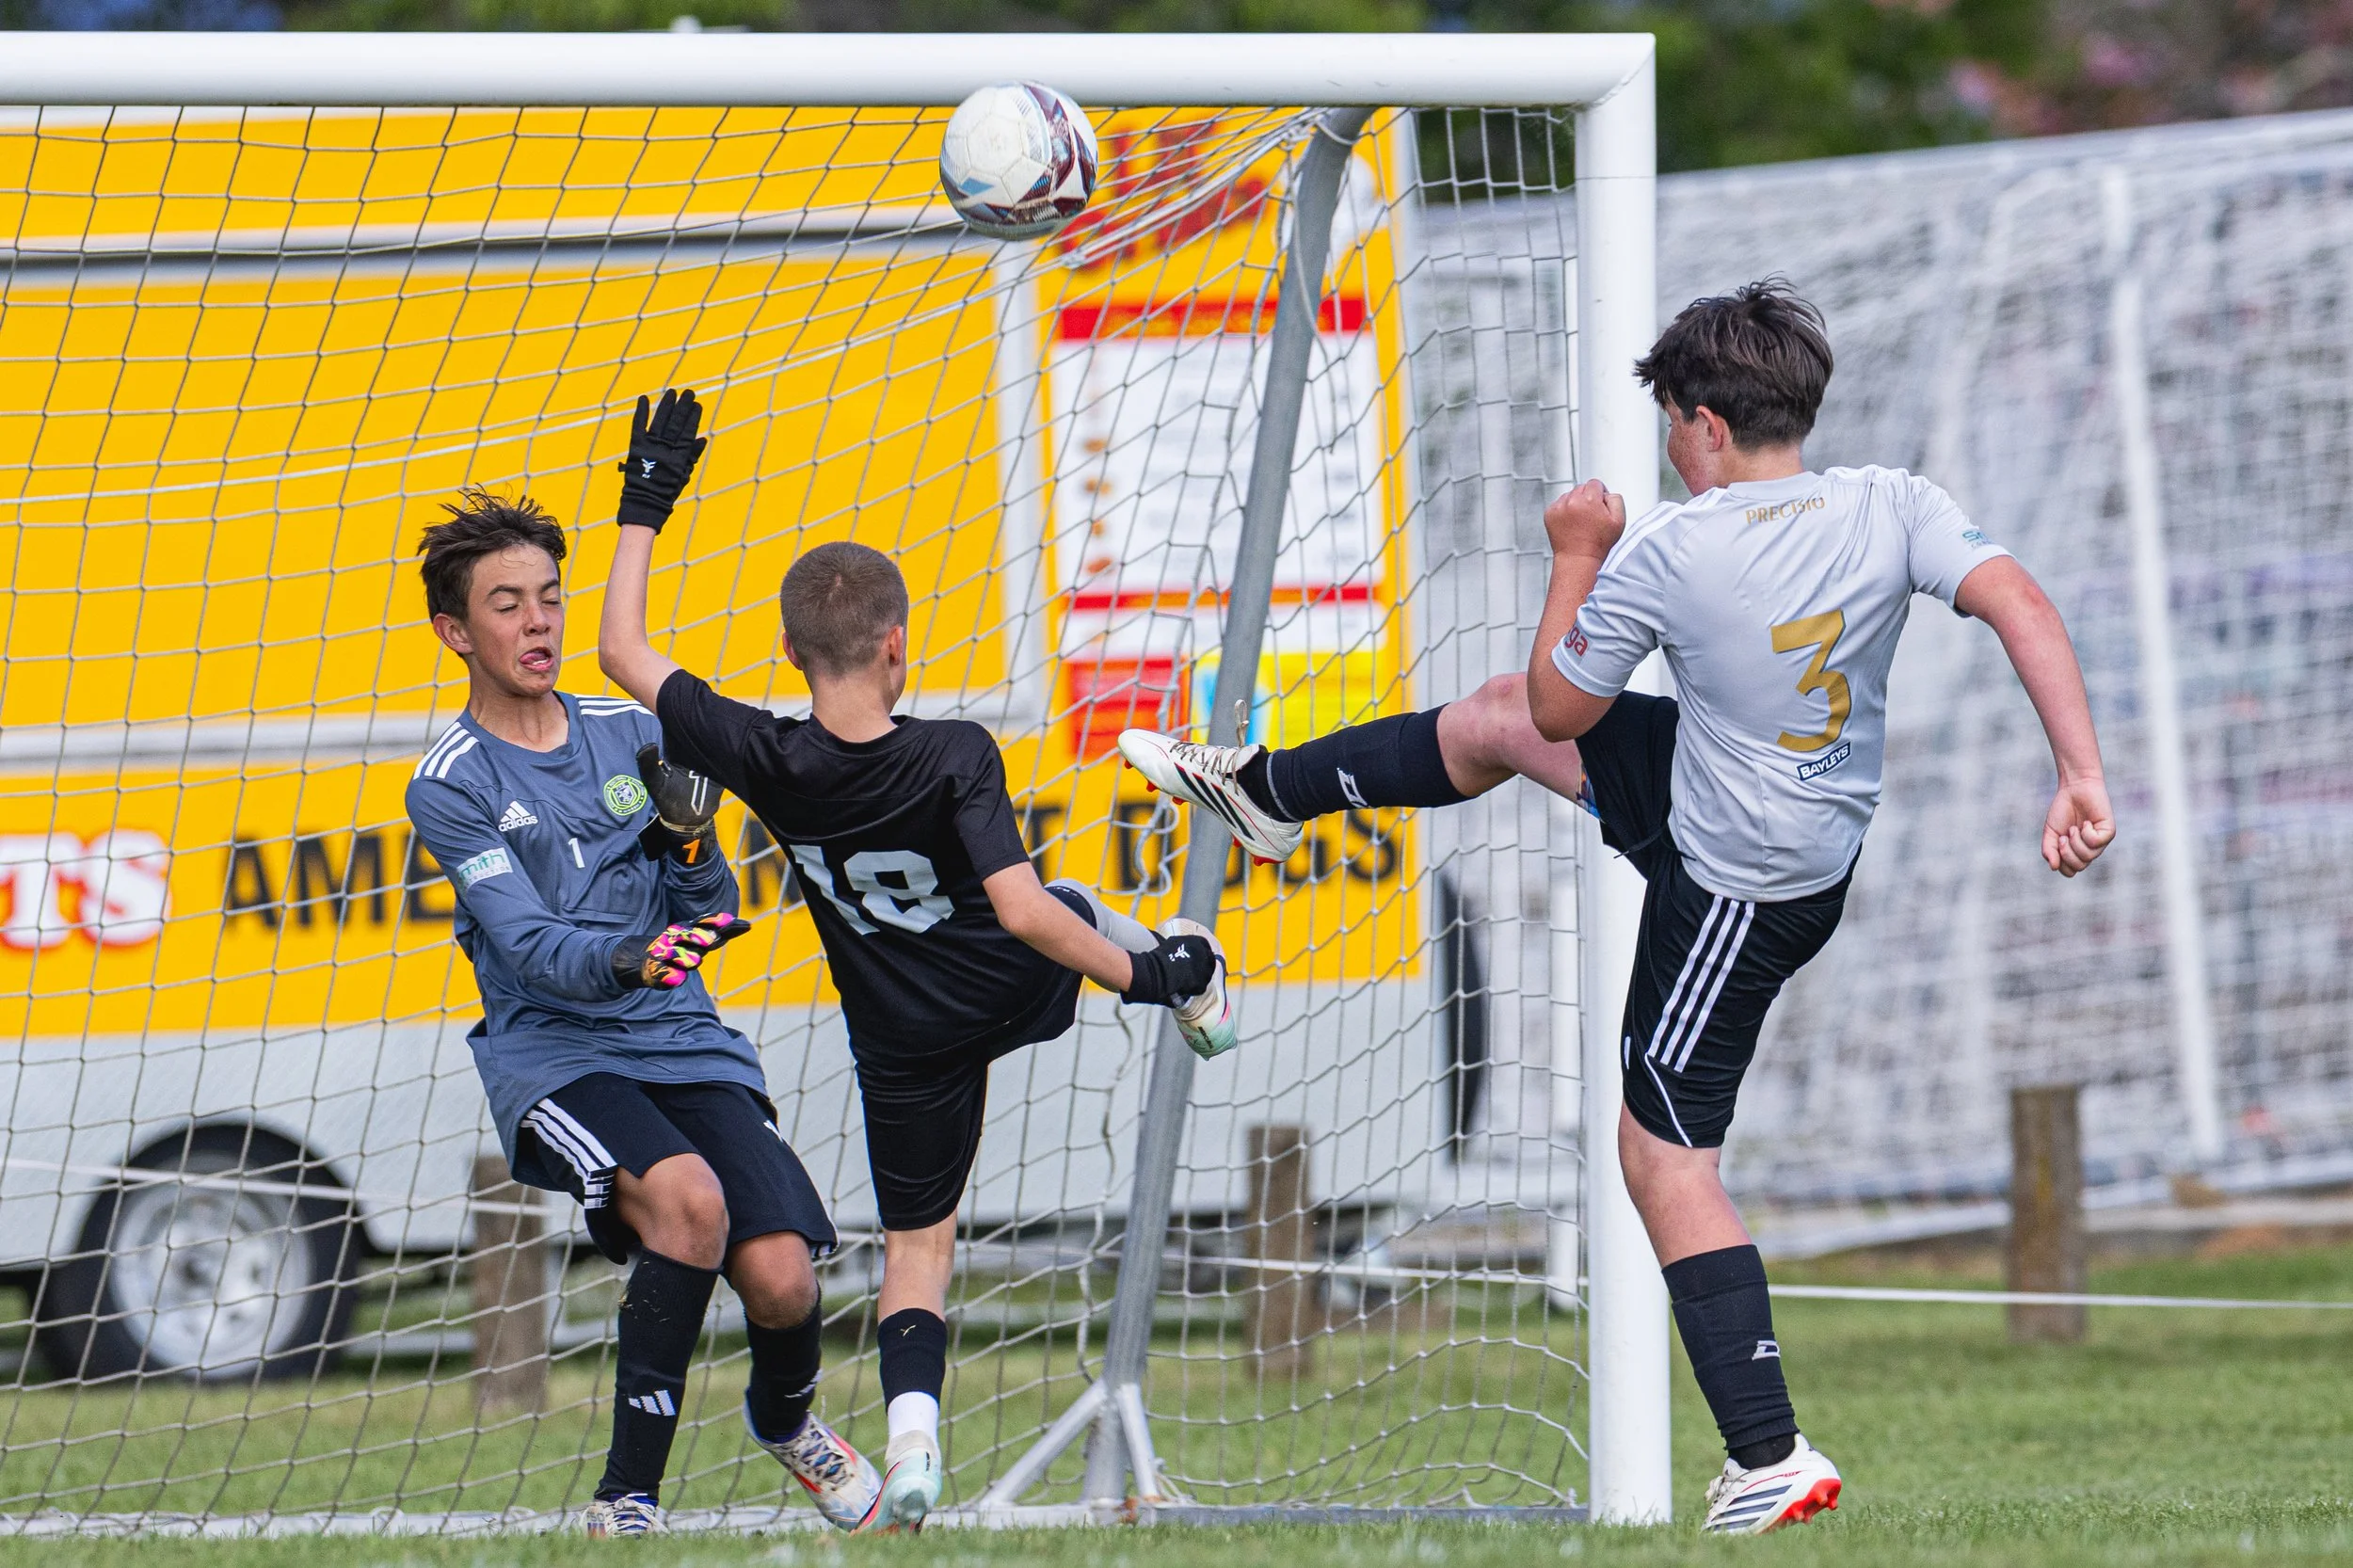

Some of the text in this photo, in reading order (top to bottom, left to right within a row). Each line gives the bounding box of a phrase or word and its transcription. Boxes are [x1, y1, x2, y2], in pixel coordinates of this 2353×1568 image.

[1770, 607, 1852, 753] 3
[1800, 744, 1849, 779] BAYLEYS
[498, 814, 538, 832] adidas
[568, 837, 585, 869] 1
[682, 839, 700, 864] 1
[459, 853, 506, 883] mith
[789, 844, 956, 936] 18
